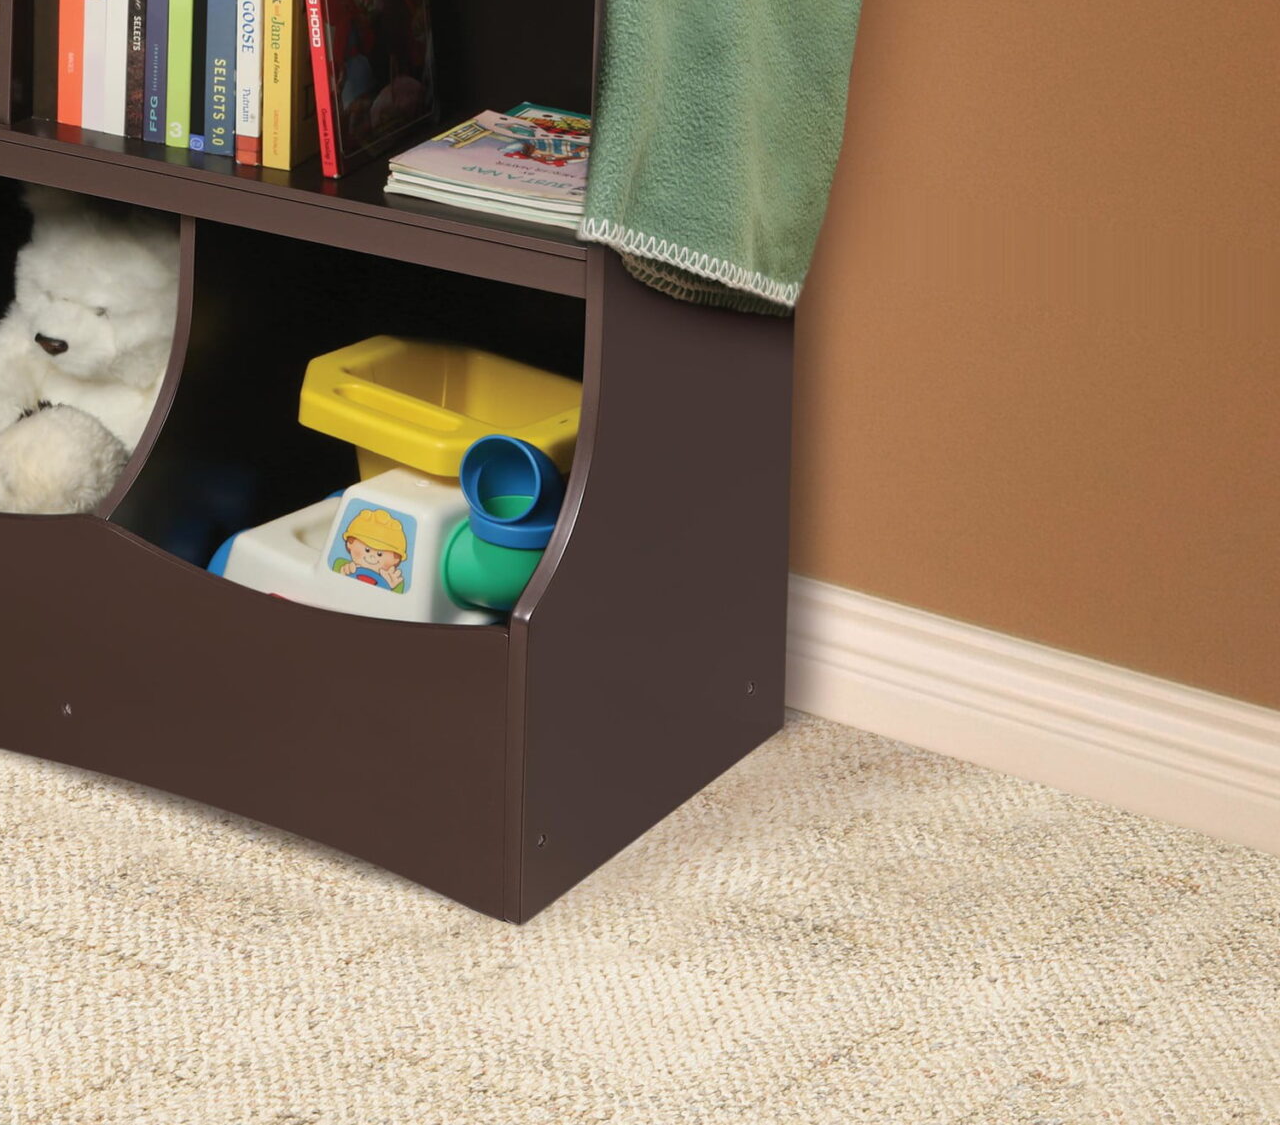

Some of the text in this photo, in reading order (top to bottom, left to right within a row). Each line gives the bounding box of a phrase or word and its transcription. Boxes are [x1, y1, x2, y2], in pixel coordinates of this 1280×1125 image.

[132, 15, 142, 51] SELECTS
[242, 0, 256, 53] GOOSE
[270, 16, 285, 49] Jane
[309, 7, 321, 48] HOOD
[149, 95, 158, 132] FPG
[212, 58, 227, 146] SELECTS 9.0
[243, 87, 251, 122] Putnam
